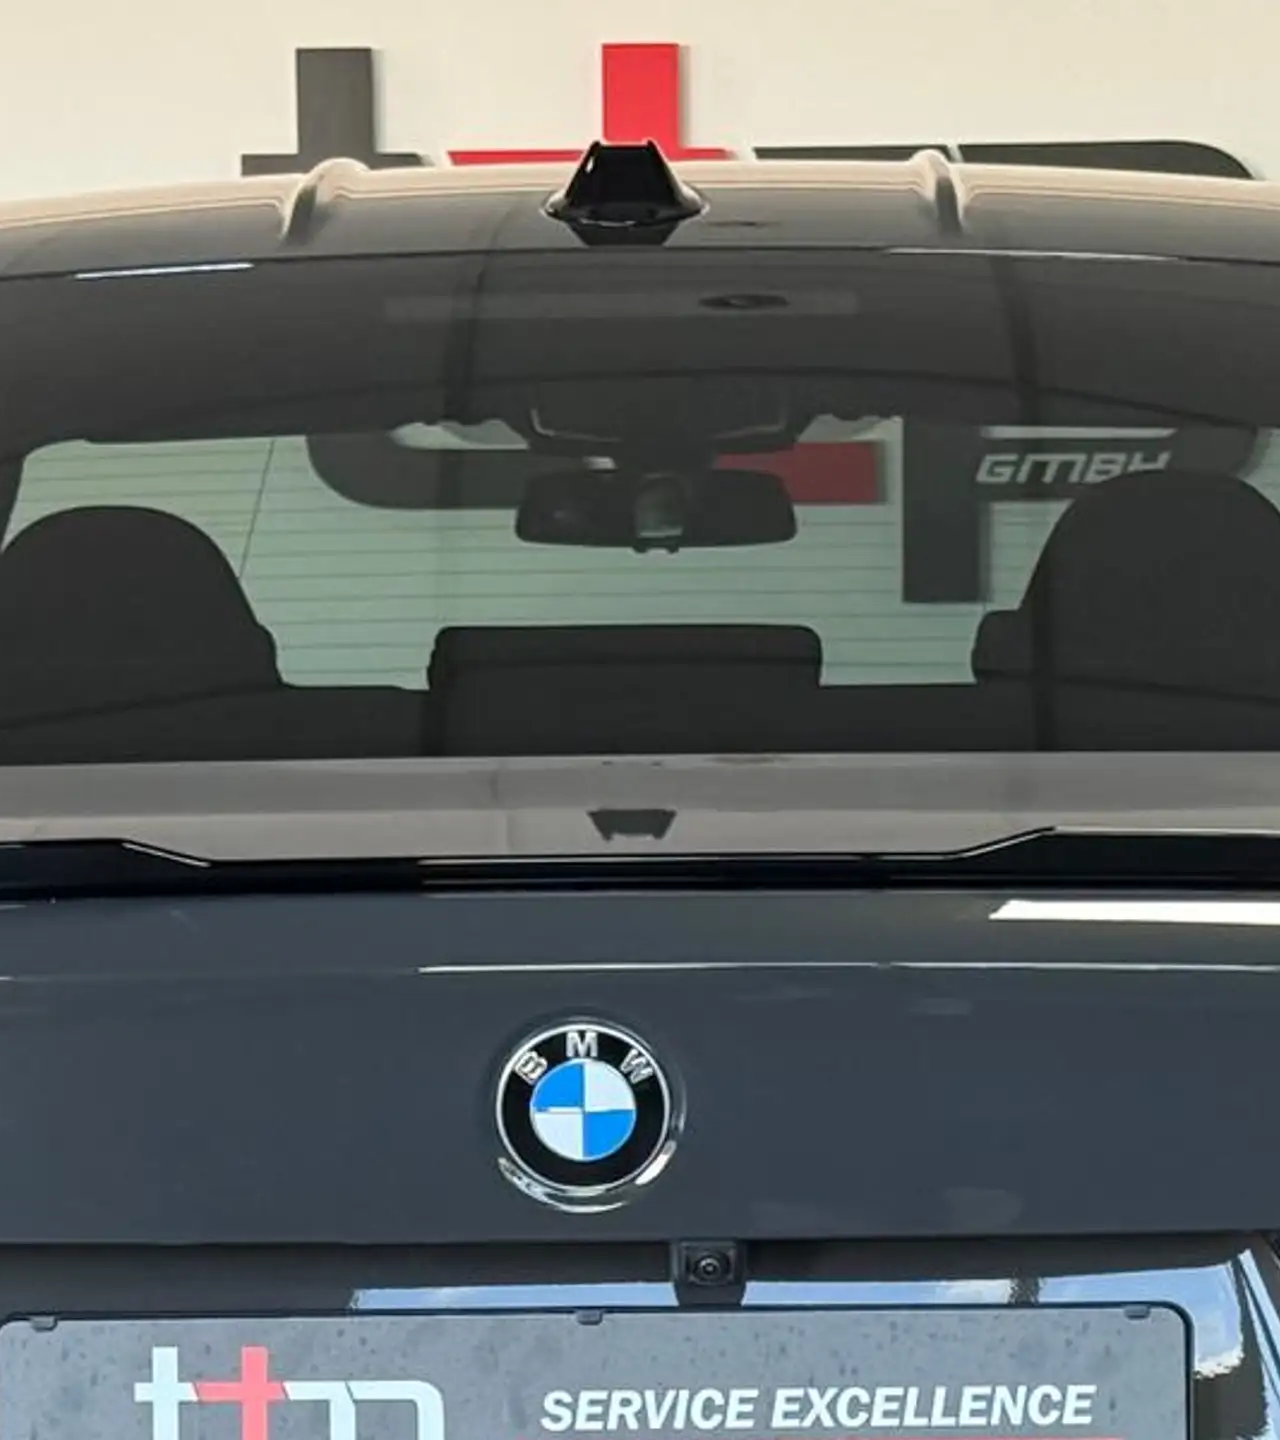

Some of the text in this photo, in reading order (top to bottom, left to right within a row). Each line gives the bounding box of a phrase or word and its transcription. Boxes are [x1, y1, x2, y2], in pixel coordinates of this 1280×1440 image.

[515, 1031, 653, 1085] BMW
[540, 1384, 1097, 1432] SERVICE EXCELLENCE
